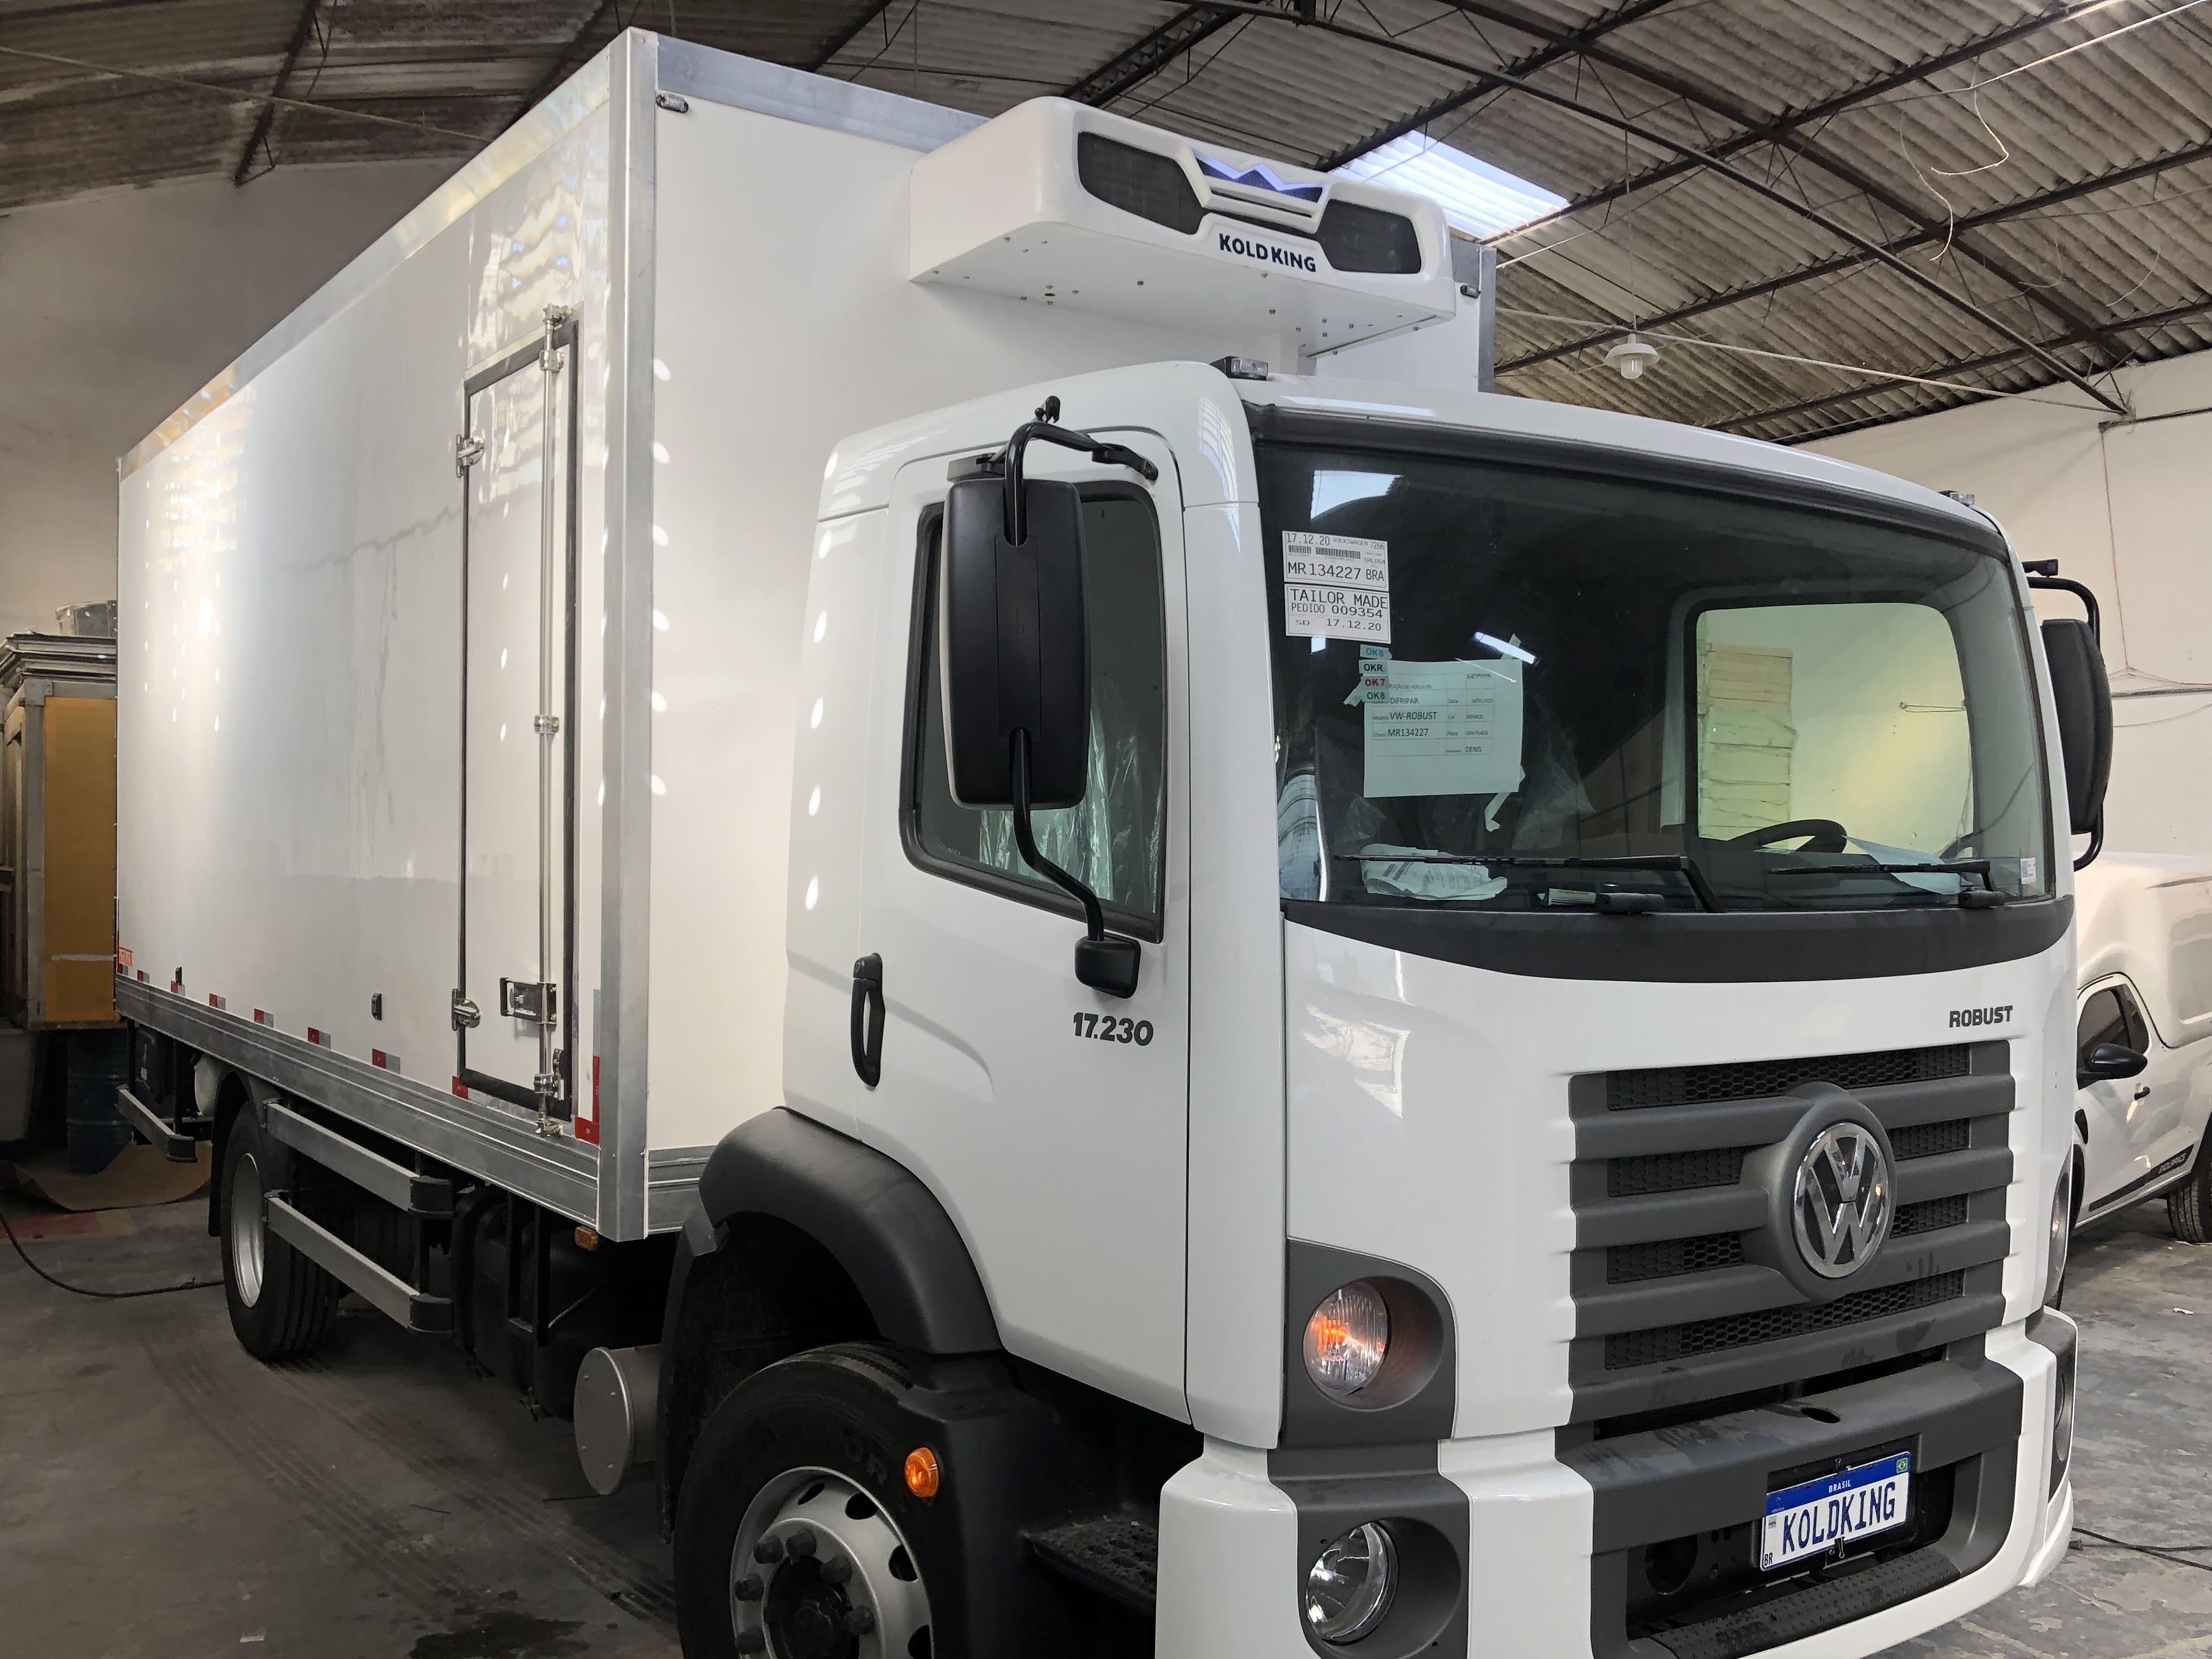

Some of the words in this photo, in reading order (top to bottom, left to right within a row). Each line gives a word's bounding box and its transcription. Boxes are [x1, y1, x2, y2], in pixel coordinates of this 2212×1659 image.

[1286, 533, 1330, 546] 17.12.20
[1333, 537, 1368, 546] VOLKSWAGEN
[1366, 569, 1385, 581] BRA
[1290, 589, 1344, 605] TAILOR
[1353, 594, 1388, 609] MADE
[1291, 603, 1325, 614] PEDIDO
[1331, 605, 1383, 619] 009354
[1326, 618, 1382, 631] 17.12.20
[1364, 663, 1383, 672] OKR
[1389, 711, 1437, 720] VW-ROBUST
[1388, 728, 1428, 737] MR134227
[1948, 1005, 2013, 1028] ROBUST
[1073, 1012, 1154, 1046] 17.230
[1828, 1479, 1851, 1493] BRASIL
[1782, 1481, 1896, 1555] KOLDKING
[1763, 1552, 1773, 1566] BR
